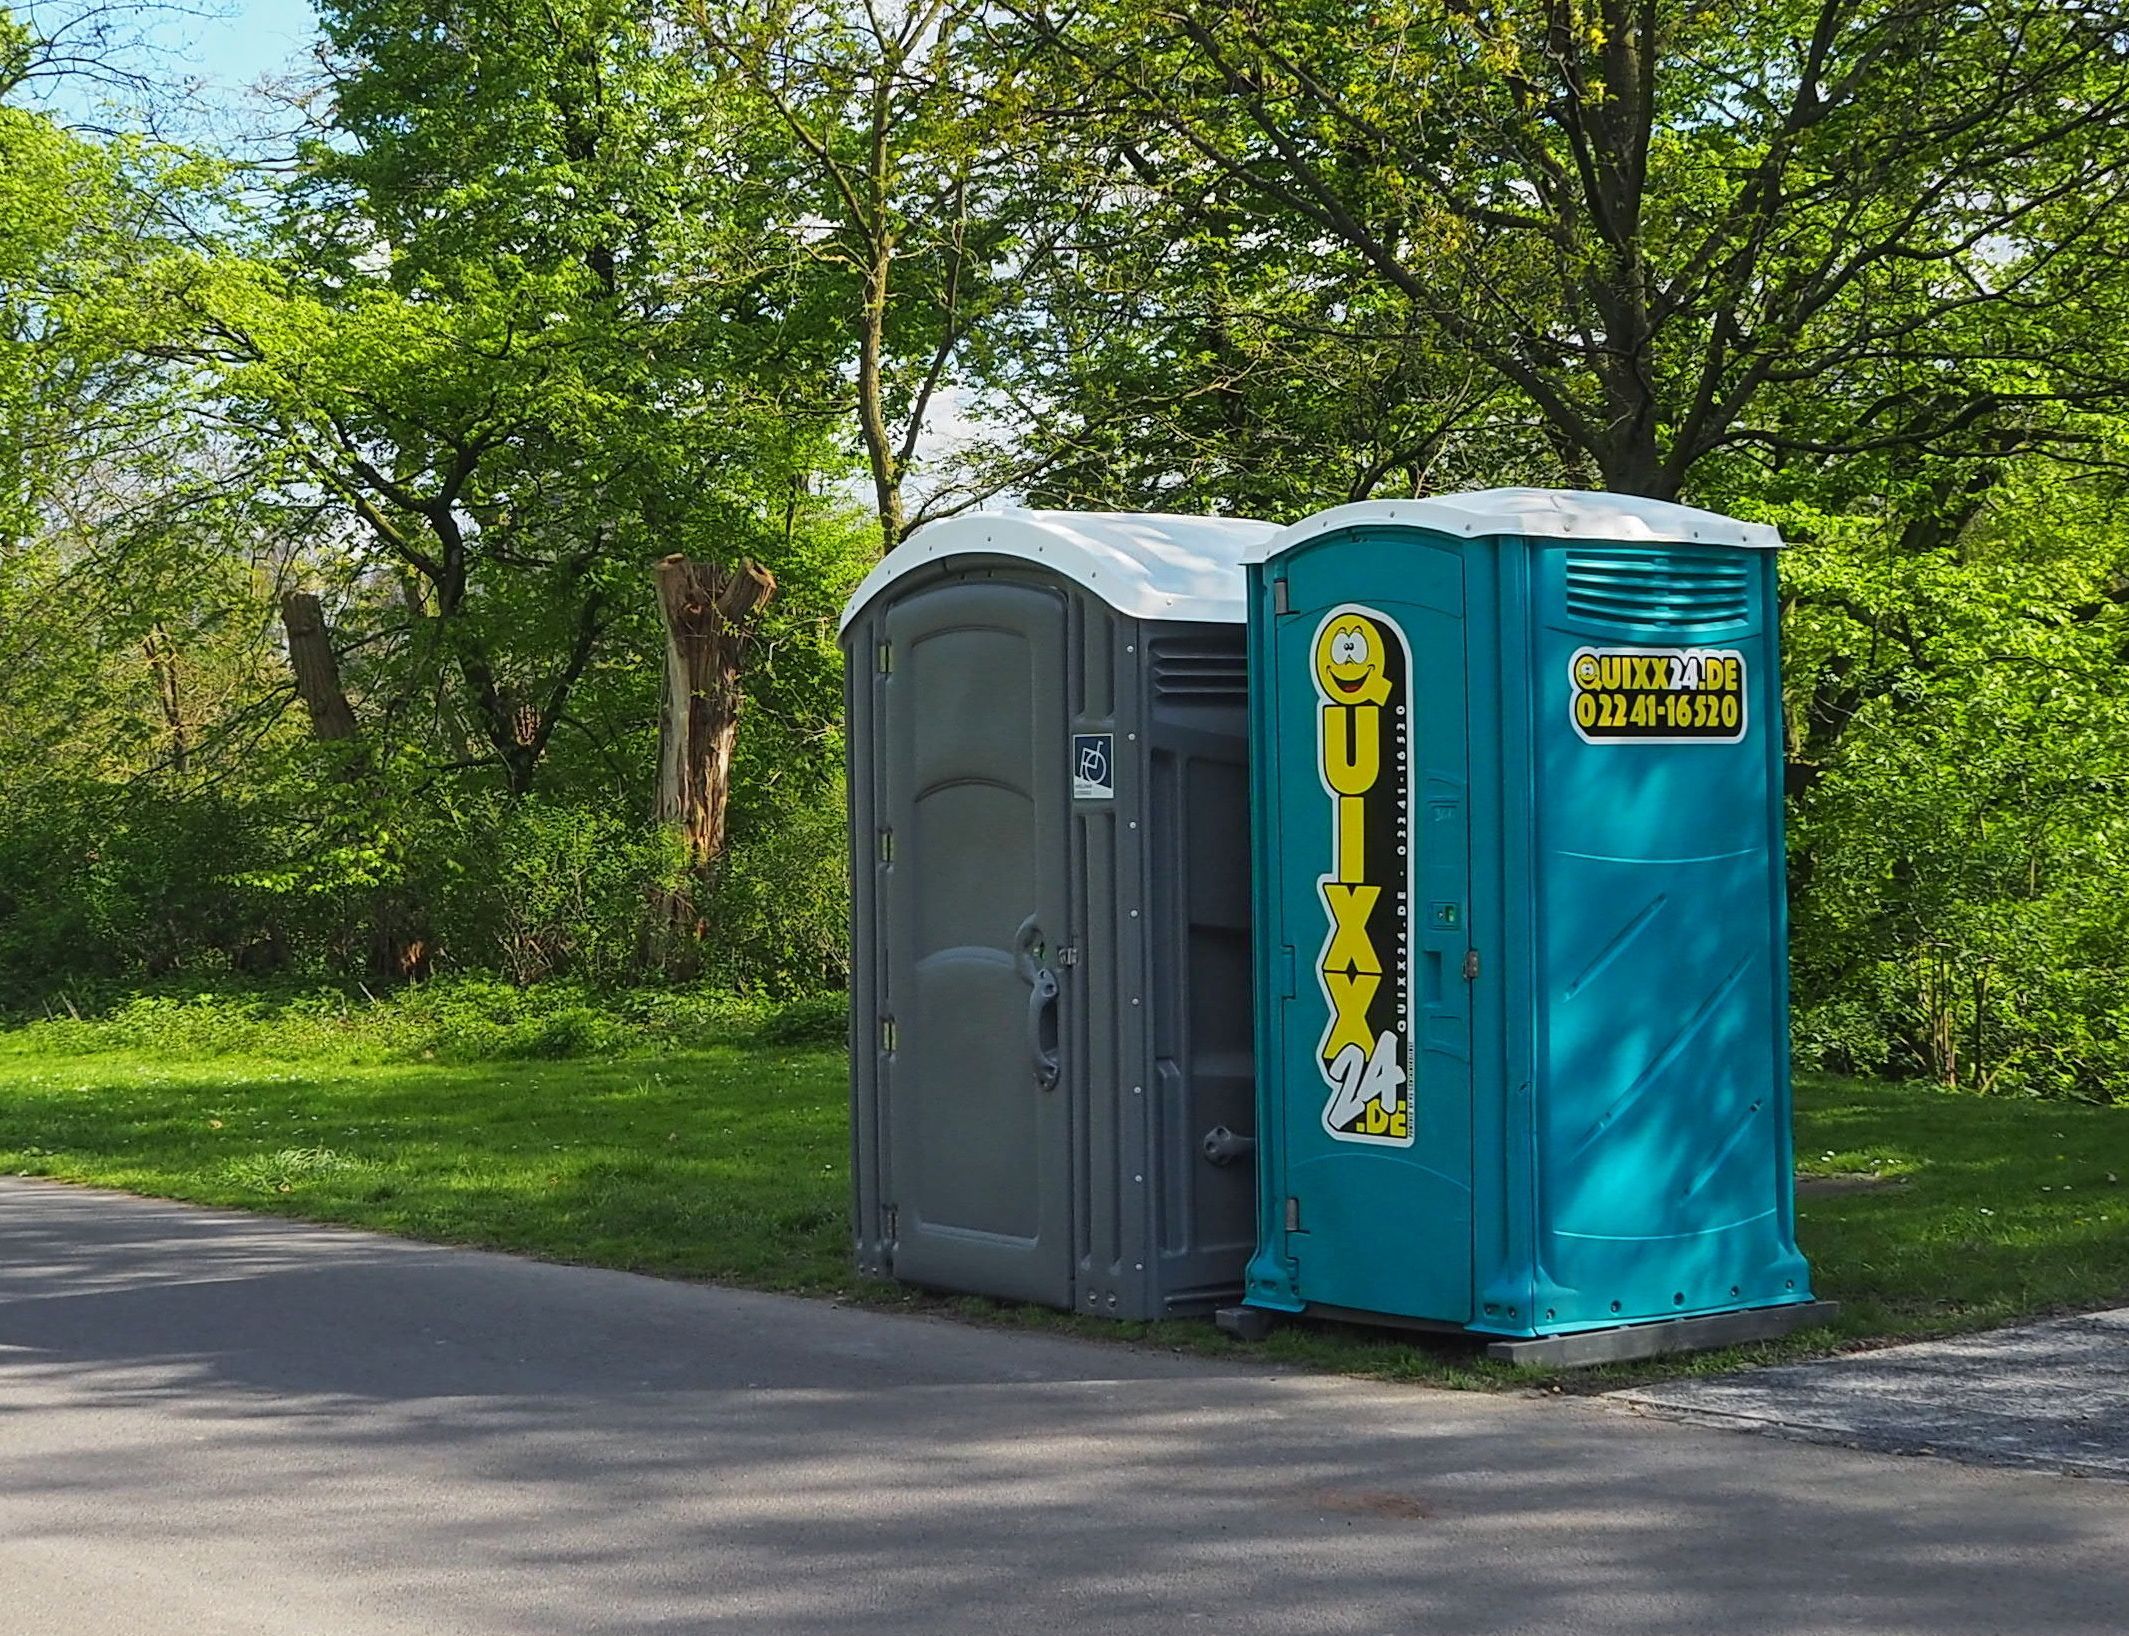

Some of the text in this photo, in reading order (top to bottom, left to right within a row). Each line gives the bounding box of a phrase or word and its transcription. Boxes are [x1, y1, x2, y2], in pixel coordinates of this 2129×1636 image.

[1577, 656, 1737, 691] QUIXX24.DE
[1578, 694, 1737, 726] 02241-16520
[1397, 891, 1406, 1033] QUIXX24.DE
